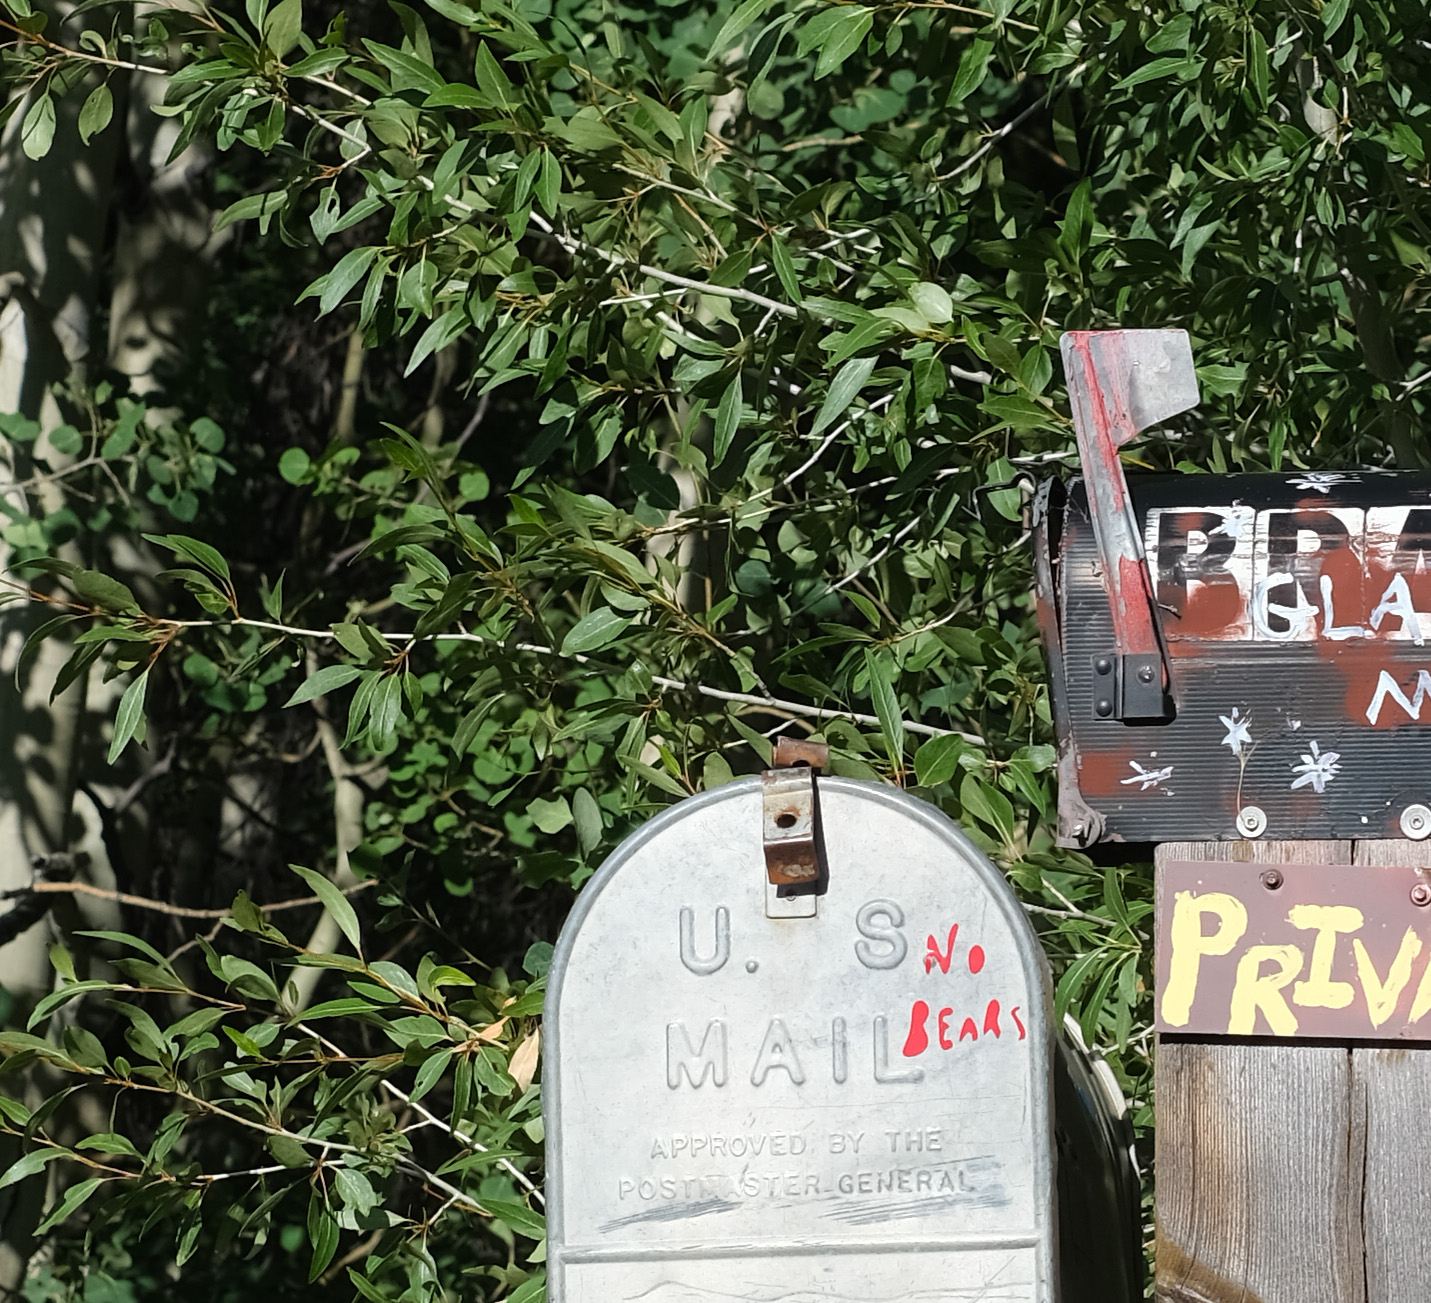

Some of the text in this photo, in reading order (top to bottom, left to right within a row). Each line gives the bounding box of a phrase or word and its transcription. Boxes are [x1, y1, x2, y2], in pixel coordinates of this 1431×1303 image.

[924, 923, 985, 974] NO
[666, 1015, 925, 1090] MAIL
[903, 999, 1026, 1057] BEARS
[651, 1127, 943, 1159] APPROVED BY THE
[618, 1170, 975, 1200] POSTMASTER GENERAL
